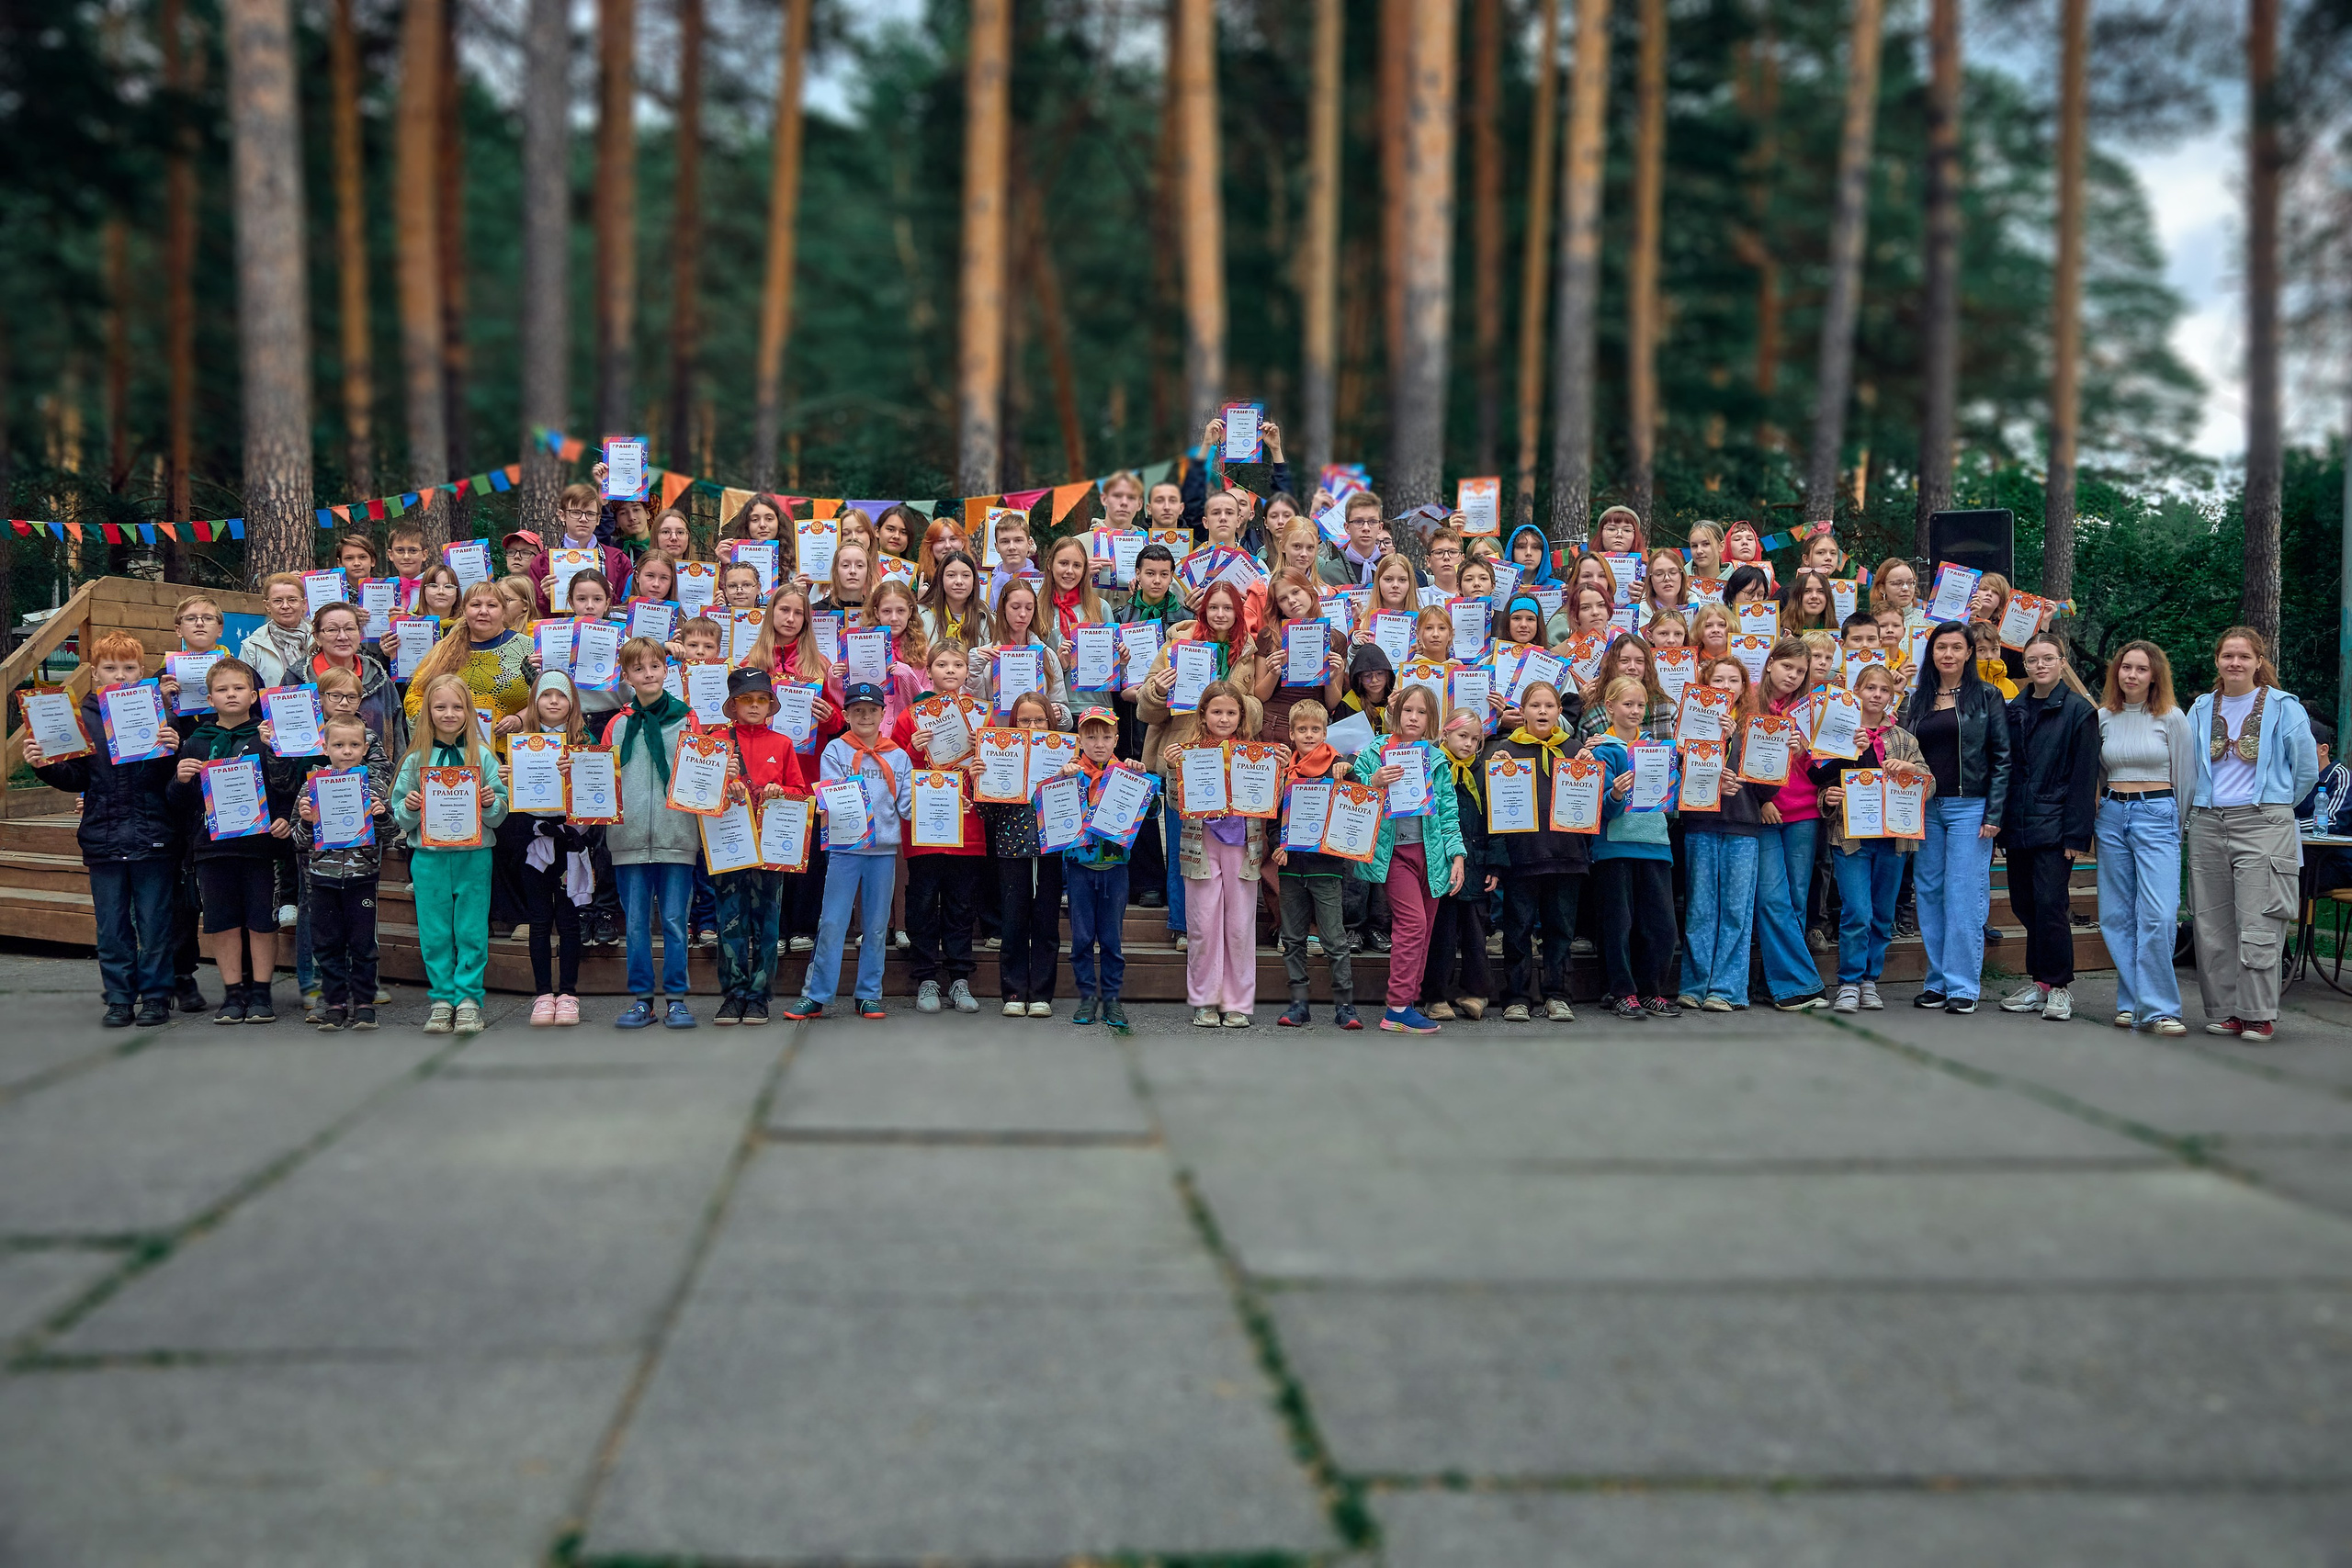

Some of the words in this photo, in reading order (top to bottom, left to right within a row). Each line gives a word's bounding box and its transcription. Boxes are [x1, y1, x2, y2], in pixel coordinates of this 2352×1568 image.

[1192, 555, 1211, 565] ГРАМО
[1947, 570, 1973, 579] ГРАМОТА
[639, 604, 669, 613] ГРАМОТА
[2010, 607, 2034, 618] ГРАМОТА
[584, 626, 615, 634] ГРАМОТА
[1532, 652, 1559, 667] ГРАМОТА
[1581, 649, 1604, 673] ГРАМОТА
[111, 689, 148, 698] ГРАМОТА
[781, 688, 810, 696] ГРАМОТА
[1689, 705, 1720, 716] ГРАМОТА
[924, 713, 956, 728] ГРАМОТА
[1753, 734, 1784, 743] ГРАМОТА
[685, 756, 720, 768] ГРАМОТА
[1237, 762, 1270, 771] ГРАМОТА
[212, 764, 248, 773] ГРАМОТА
[321, 776, 356, 784] ГРАМОТА
[1116, 770, 1146, 786] ГРАМОТА
[825, 784, 855, 793] ГРАМОТА
[1045, 781, 1073, 791] ГРАМОТА
[1890, 788, 1917, 796] ГРАМОТА
[1339, 804, 1372, 815] ГРАМОТА
